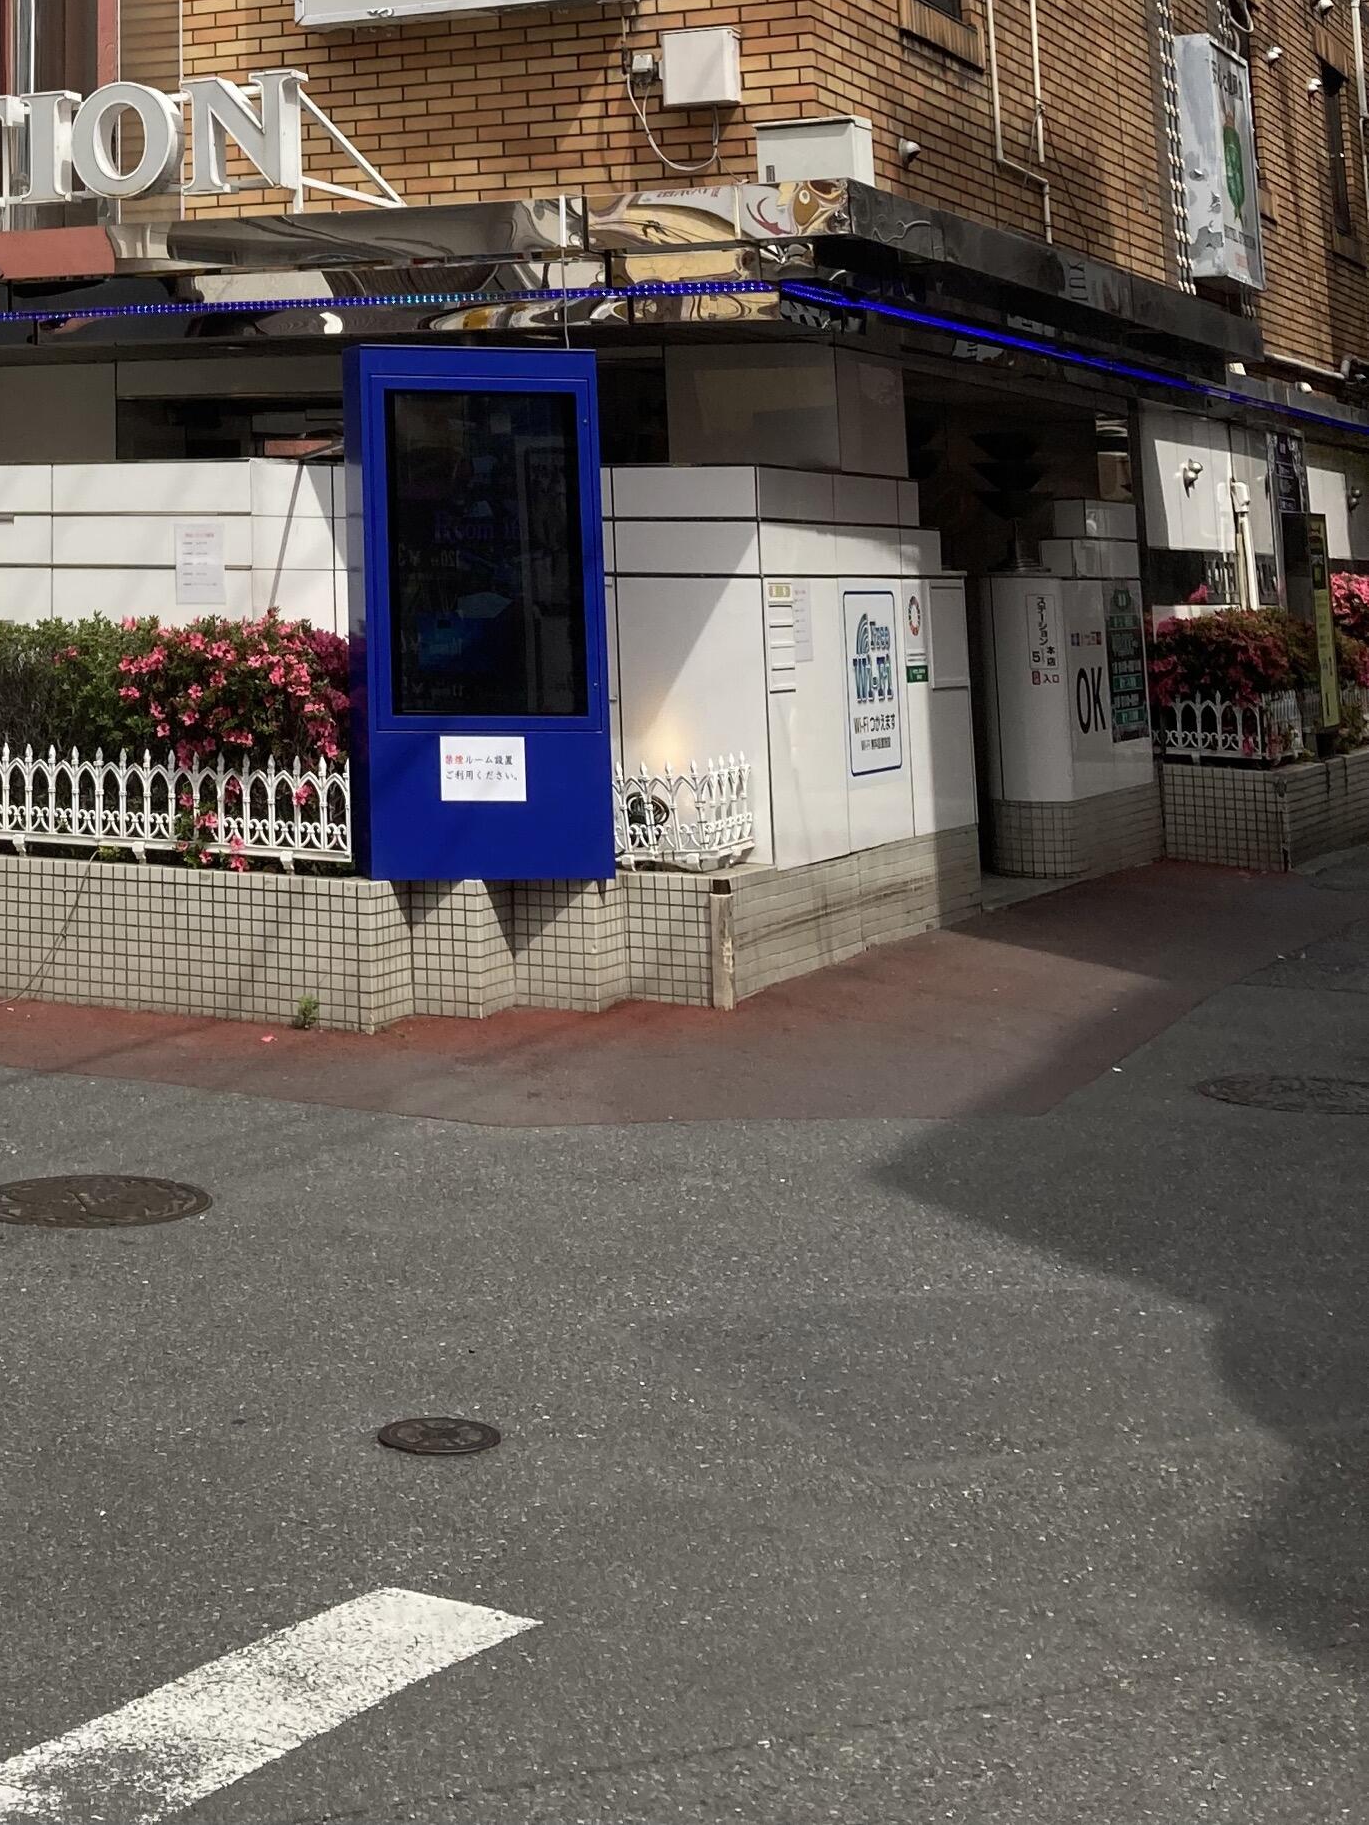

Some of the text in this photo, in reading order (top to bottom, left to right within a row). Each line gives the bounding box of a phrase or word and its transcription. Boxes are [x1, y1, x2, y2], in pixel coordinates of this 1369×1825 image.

[1037, 596, 1049, 646] ステーション
[870, 621, 891, 650] Free
[852, 653, 894, 703] Wi-Fi
[1043, 673, 1060, 684] 入口
[1077, 666, 1106, 734] OK
[870, 714, 895, 731] つかえます
[445, 755, 513, 766] 禁煙ルーム設置
[446, 770, 518, 781] ご利用ください。
